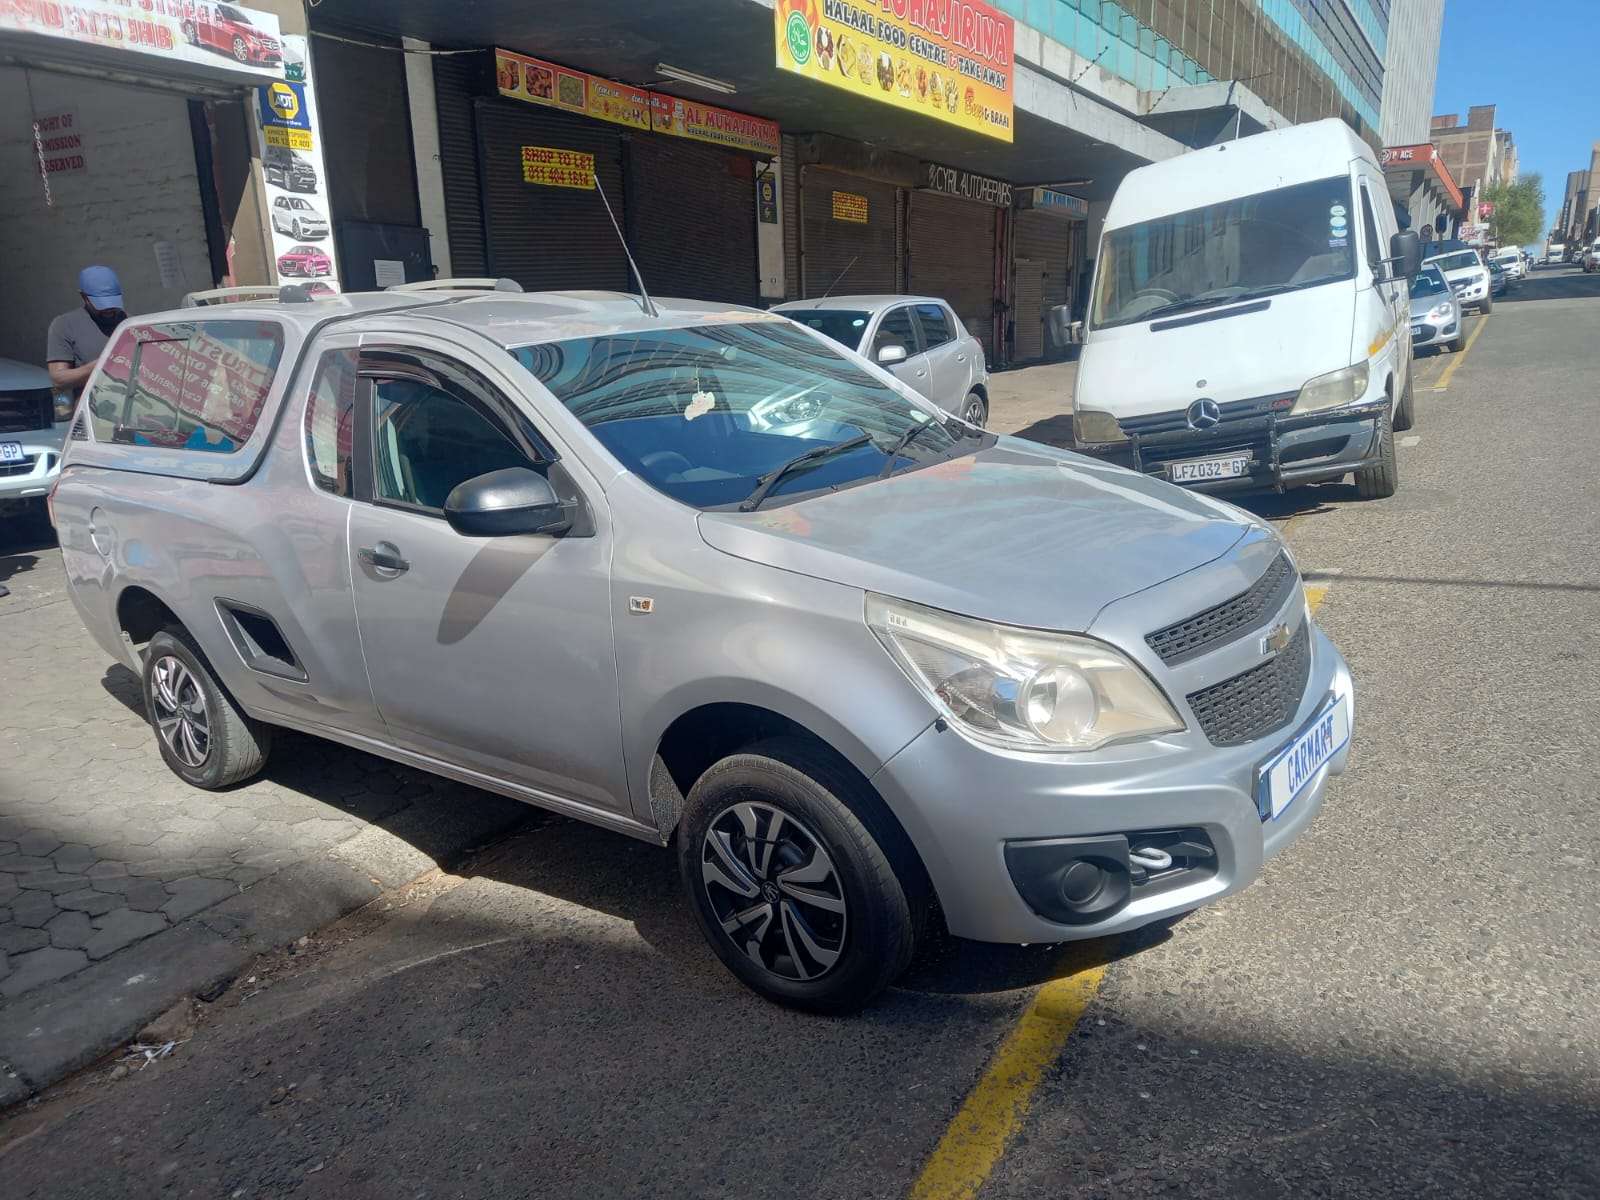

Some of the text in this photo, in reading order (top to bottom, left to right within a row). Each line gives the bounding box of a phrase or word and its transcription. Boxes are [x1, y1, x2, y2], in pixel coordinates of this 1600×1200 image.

[866, 0, 1008, 66] HAJIRINA
[823, 0, 1007, 91] HALAAL FOOD CENTRE & TAKE AWAY
[274, 93, 293, 109] ADT
[61, 113, 73, 128] OF
[686, 105, 702, 124] AL
[525, 147, 592, 169] SHOP TO LET
[2, 444, 18, 459] GP
[1232, 458, 1247, 474] GP
[1287, 714, 1334, 794] CARMART
